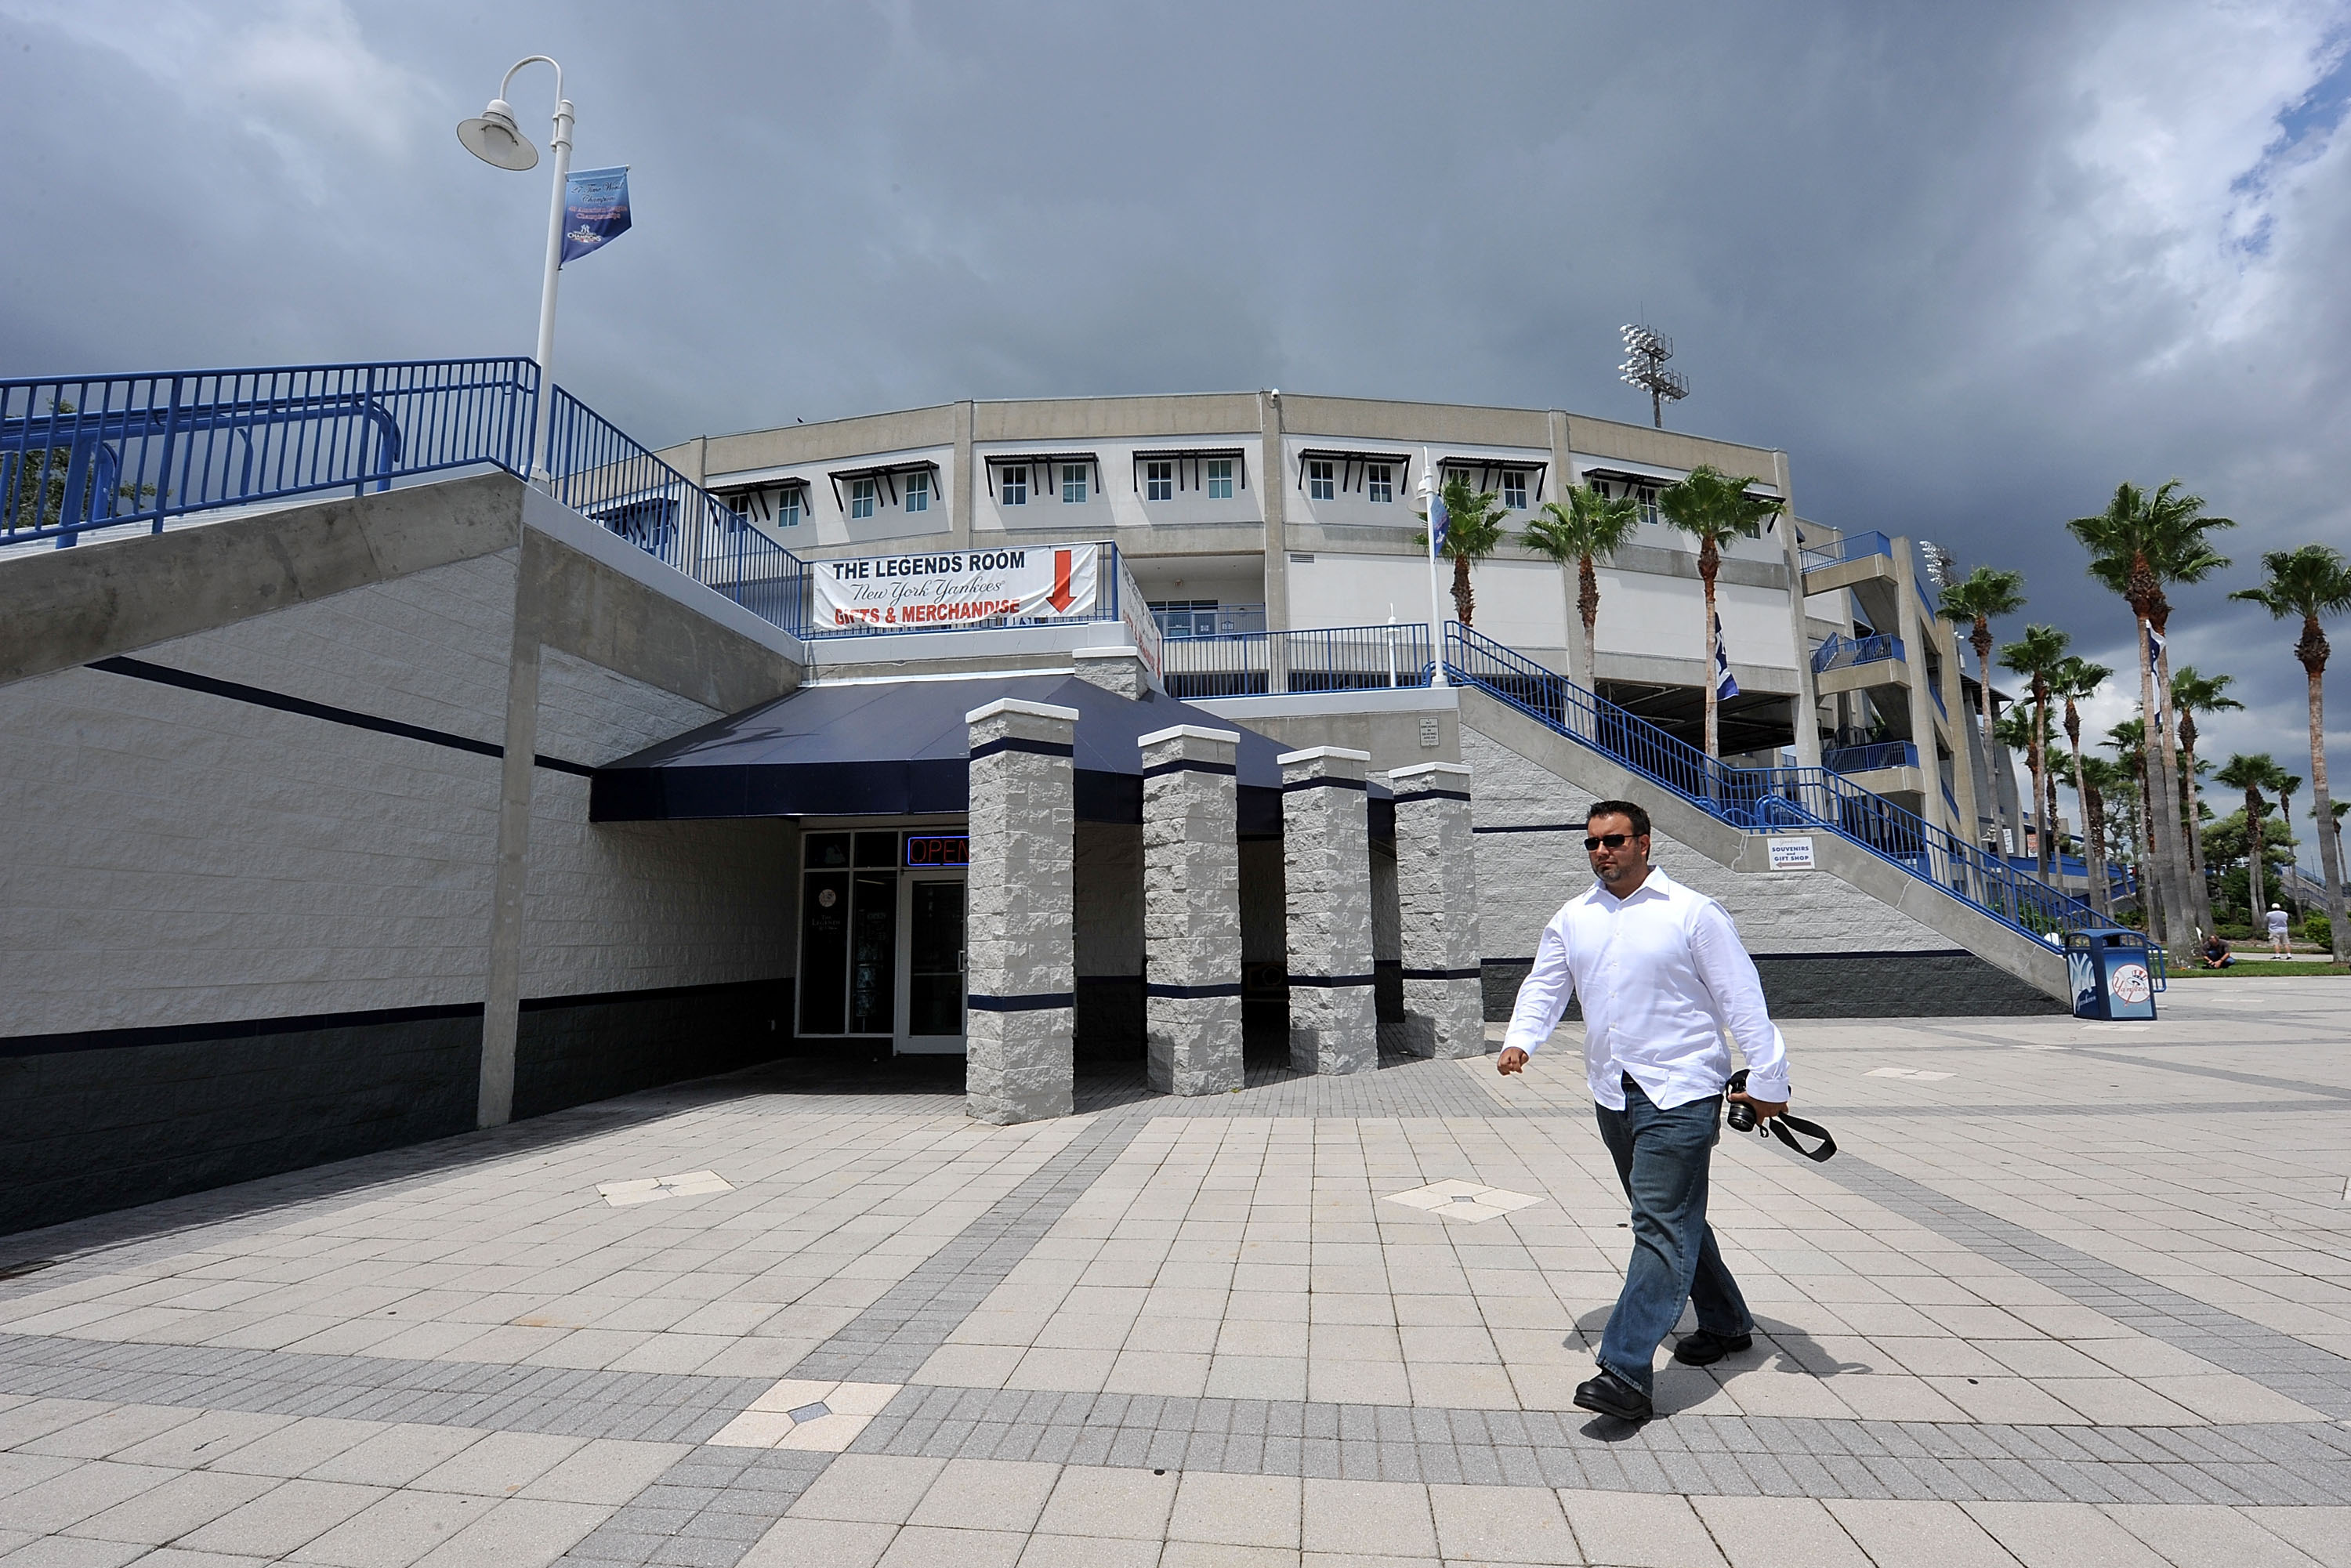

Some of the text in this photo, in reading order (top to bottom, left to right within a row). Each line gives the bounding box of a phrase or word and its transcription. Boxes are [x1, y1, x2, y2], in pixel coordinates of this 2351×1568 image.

[833, 551, 1026, 580] THE LEGENDS ROOM
[851, 577, 1002, 607] New York Yankees
[835, 599, 1020, 625] GIFTS & MERCHANDISE
[911, 840, 969, 862] OPEN
